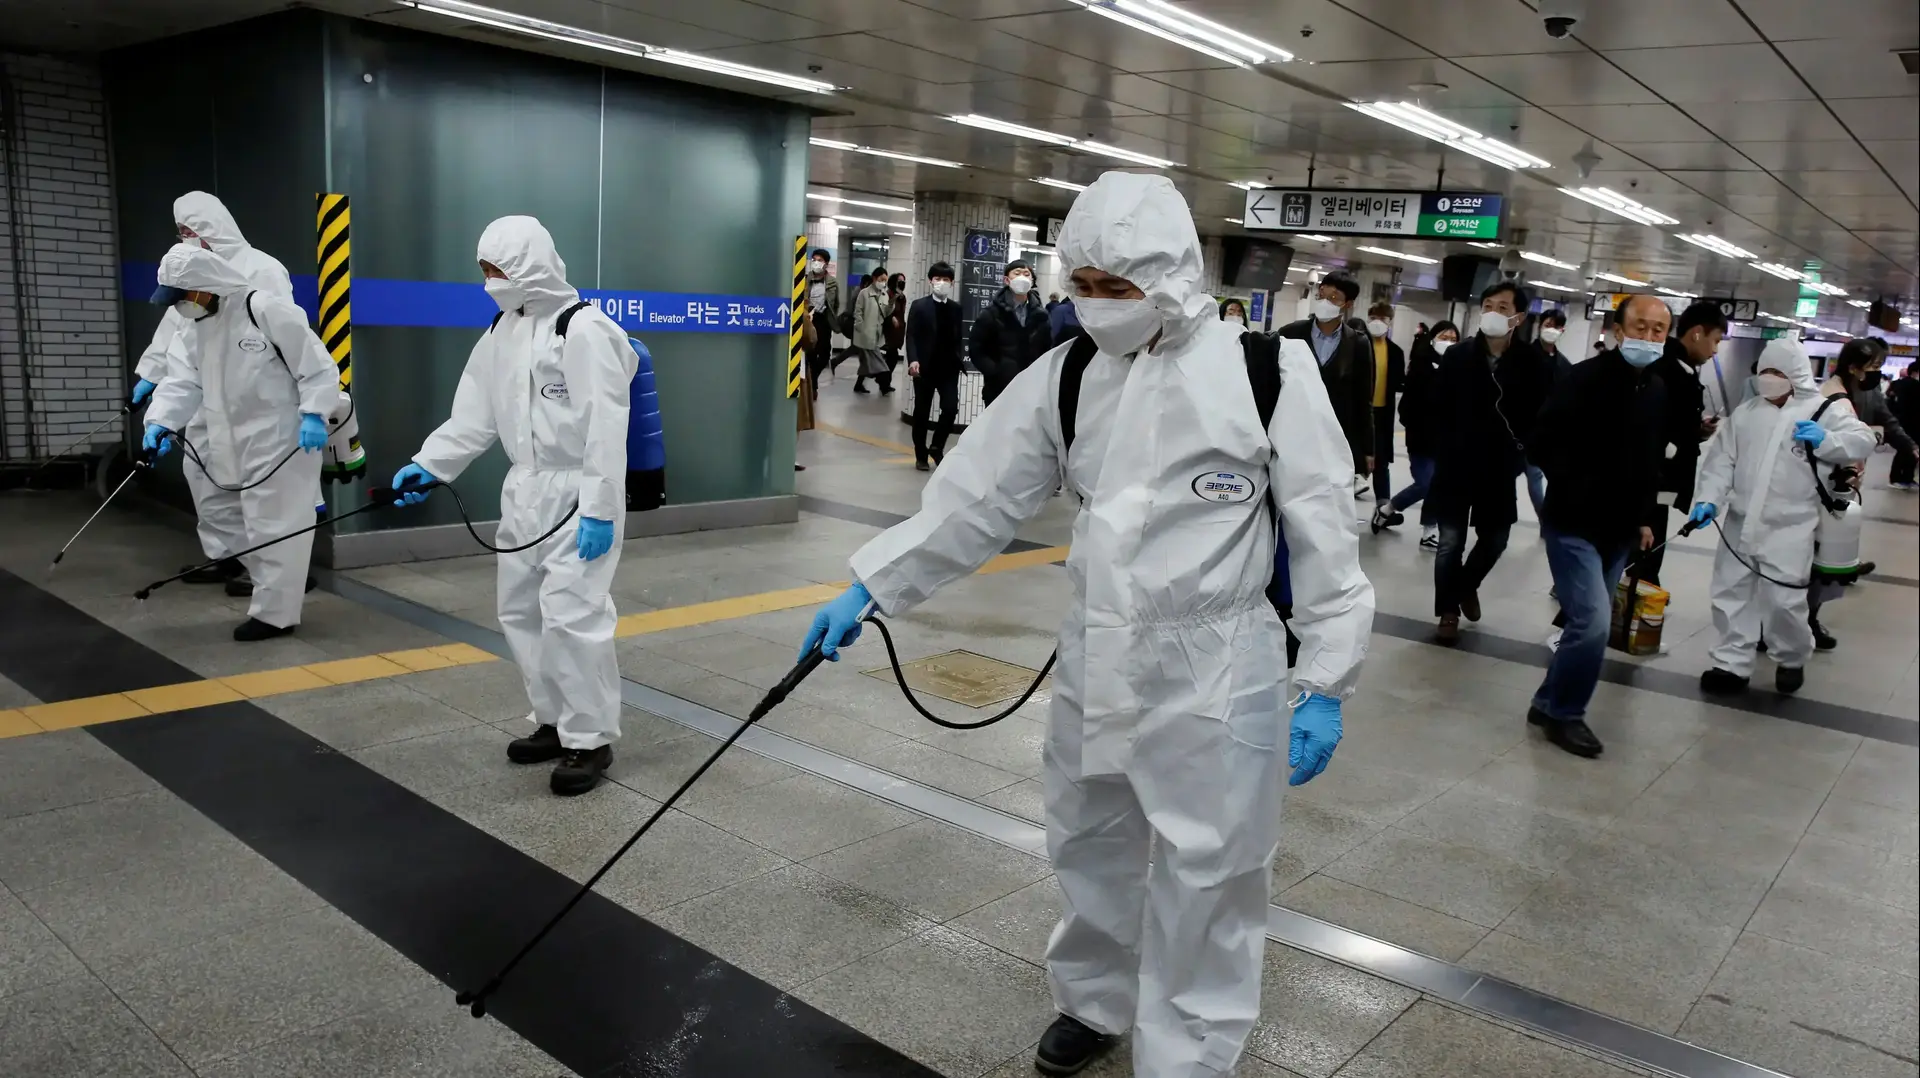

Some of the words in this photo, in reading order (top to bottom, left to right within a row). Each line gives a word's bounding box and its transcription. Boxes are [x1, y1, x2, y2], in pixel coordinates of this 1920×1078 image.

[1321, 196, 1406, 218] 엘리베이터
[1452, 198, 1482, 207] 소요산
[1320, 218, 1356, 228] Elevator
[1449, 219, 1480, 228] 까치산
[687, 301, 720, 325] 타는
[726, 303, 742, 326] 곳
[743, 304, 765, 314] Tracks
[649, 313, 686, 324] Elevator
[1204, 481, 1244, 492] 크린가드
[1217, 493, 1229, 501] A40
